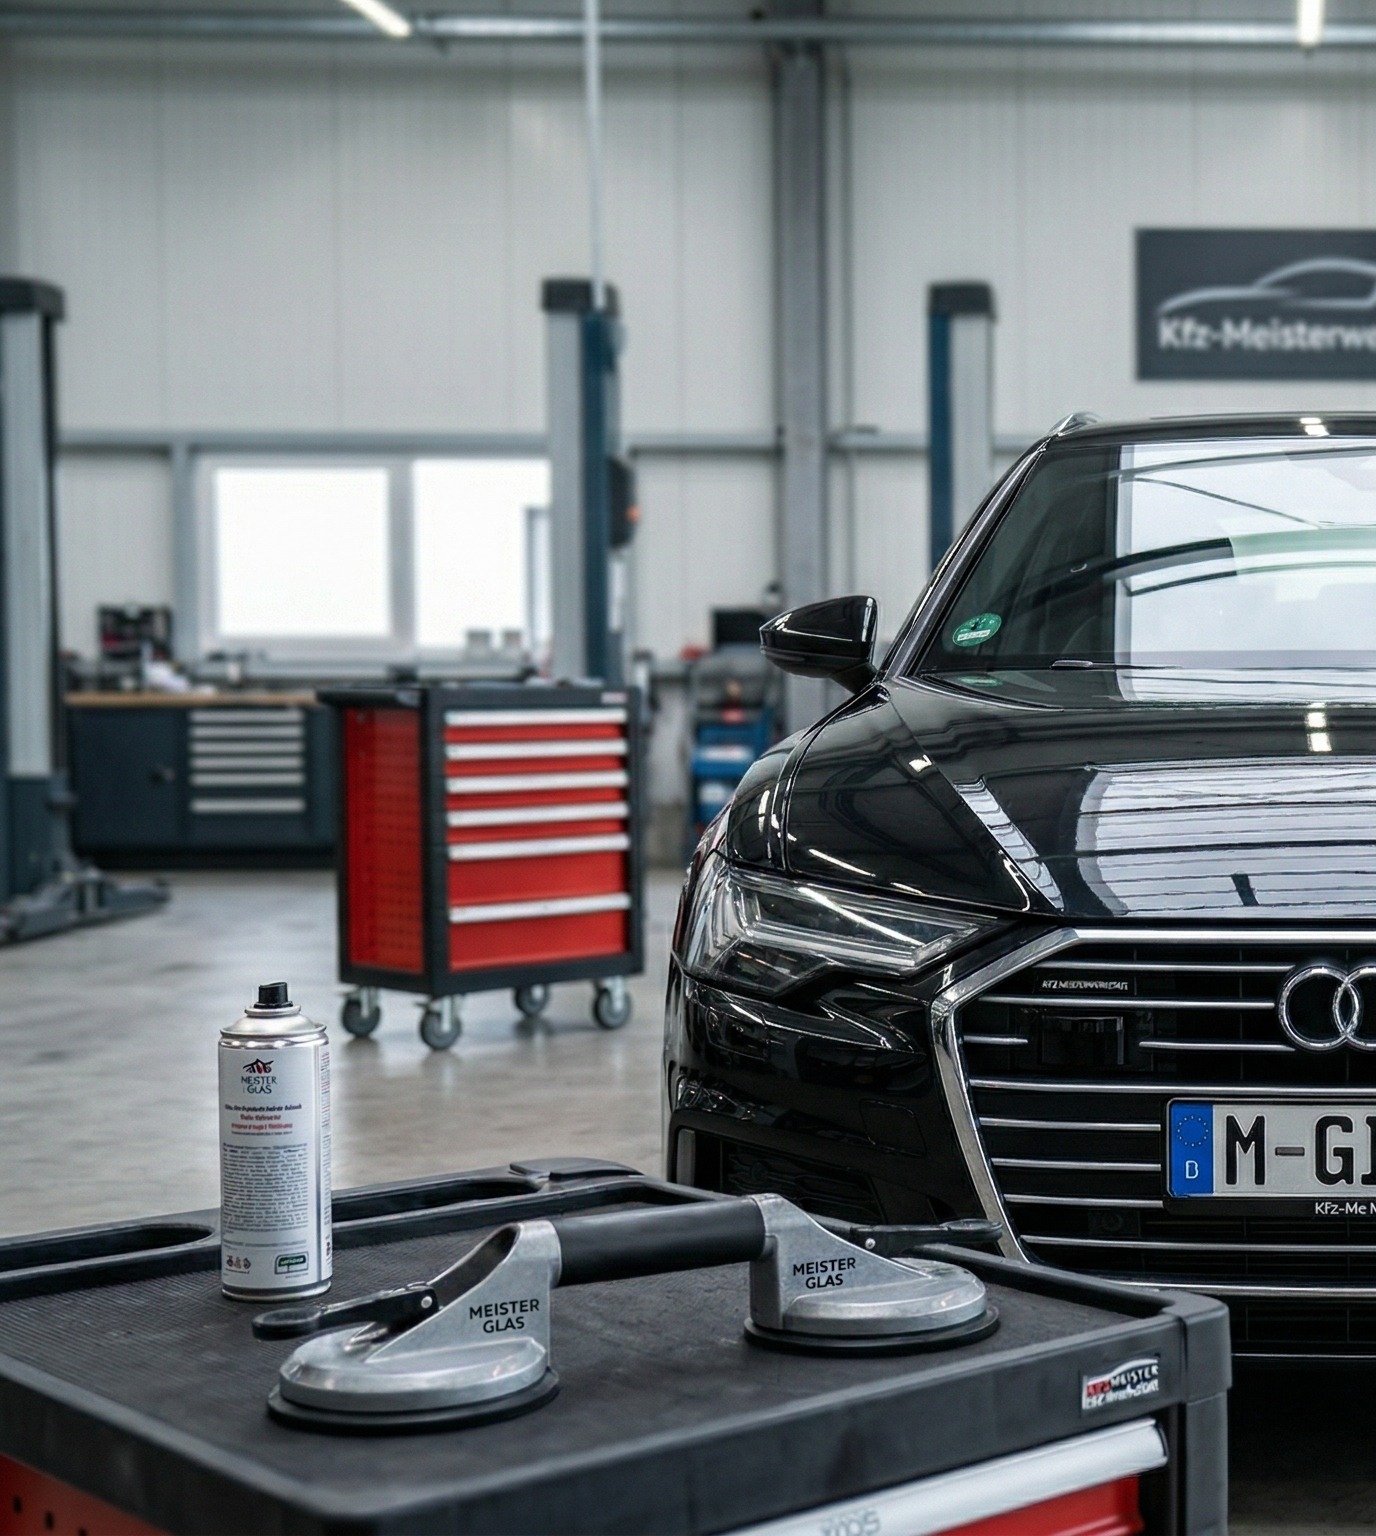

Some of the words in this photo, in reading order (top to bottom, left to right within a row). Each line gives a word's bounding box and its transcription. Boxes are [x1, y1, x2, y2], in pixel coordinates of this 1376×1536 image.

[793, 1257, 856, 1276] MEISTER
[805, 1273, 844, 1290] GLAS
[469, 1299, 540, 1320] MEISTER
[482, 1316, 525, 1334] GLAS
